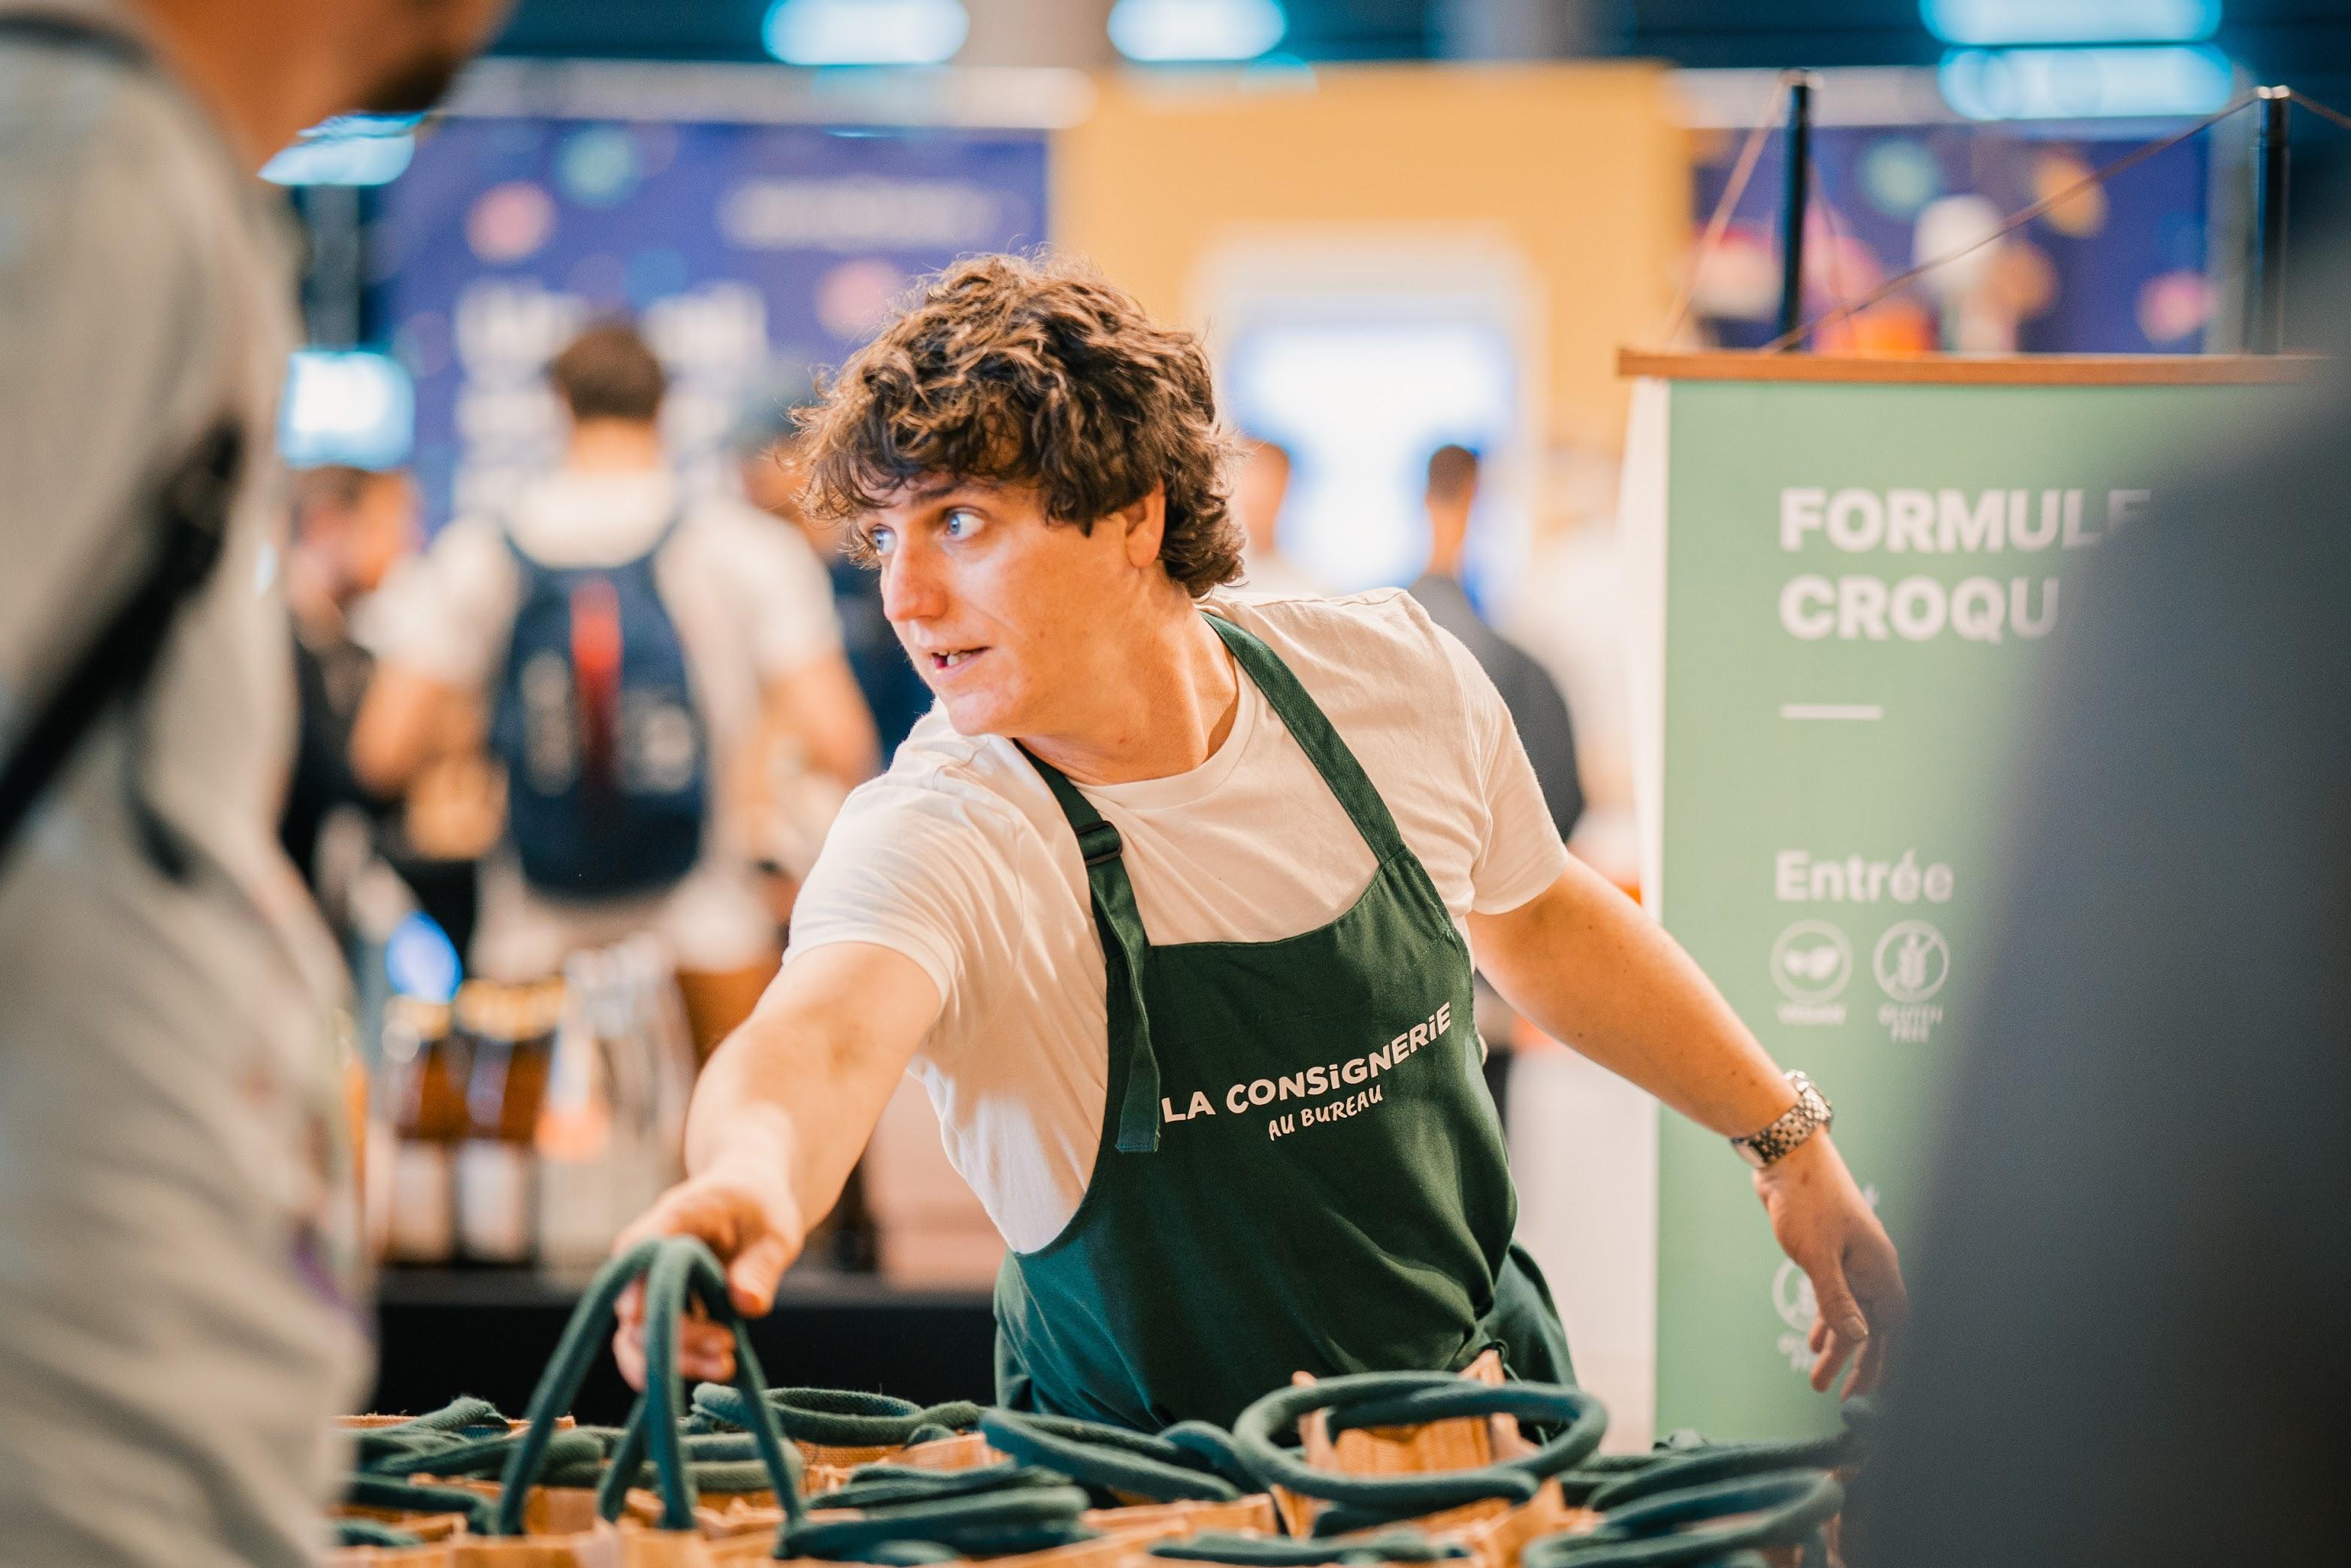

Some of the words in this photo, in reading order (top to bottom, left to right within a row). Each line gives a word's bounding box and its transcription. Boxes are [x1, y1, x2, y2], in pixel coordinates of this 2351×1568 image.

[1775, 849, 1953, 903] Entrée
[1161, 1091, 1215, 1123] LA
[1268, 1115, 1295, 1141] AU
[1302, 1085, 1383, 1128] BUREAU
